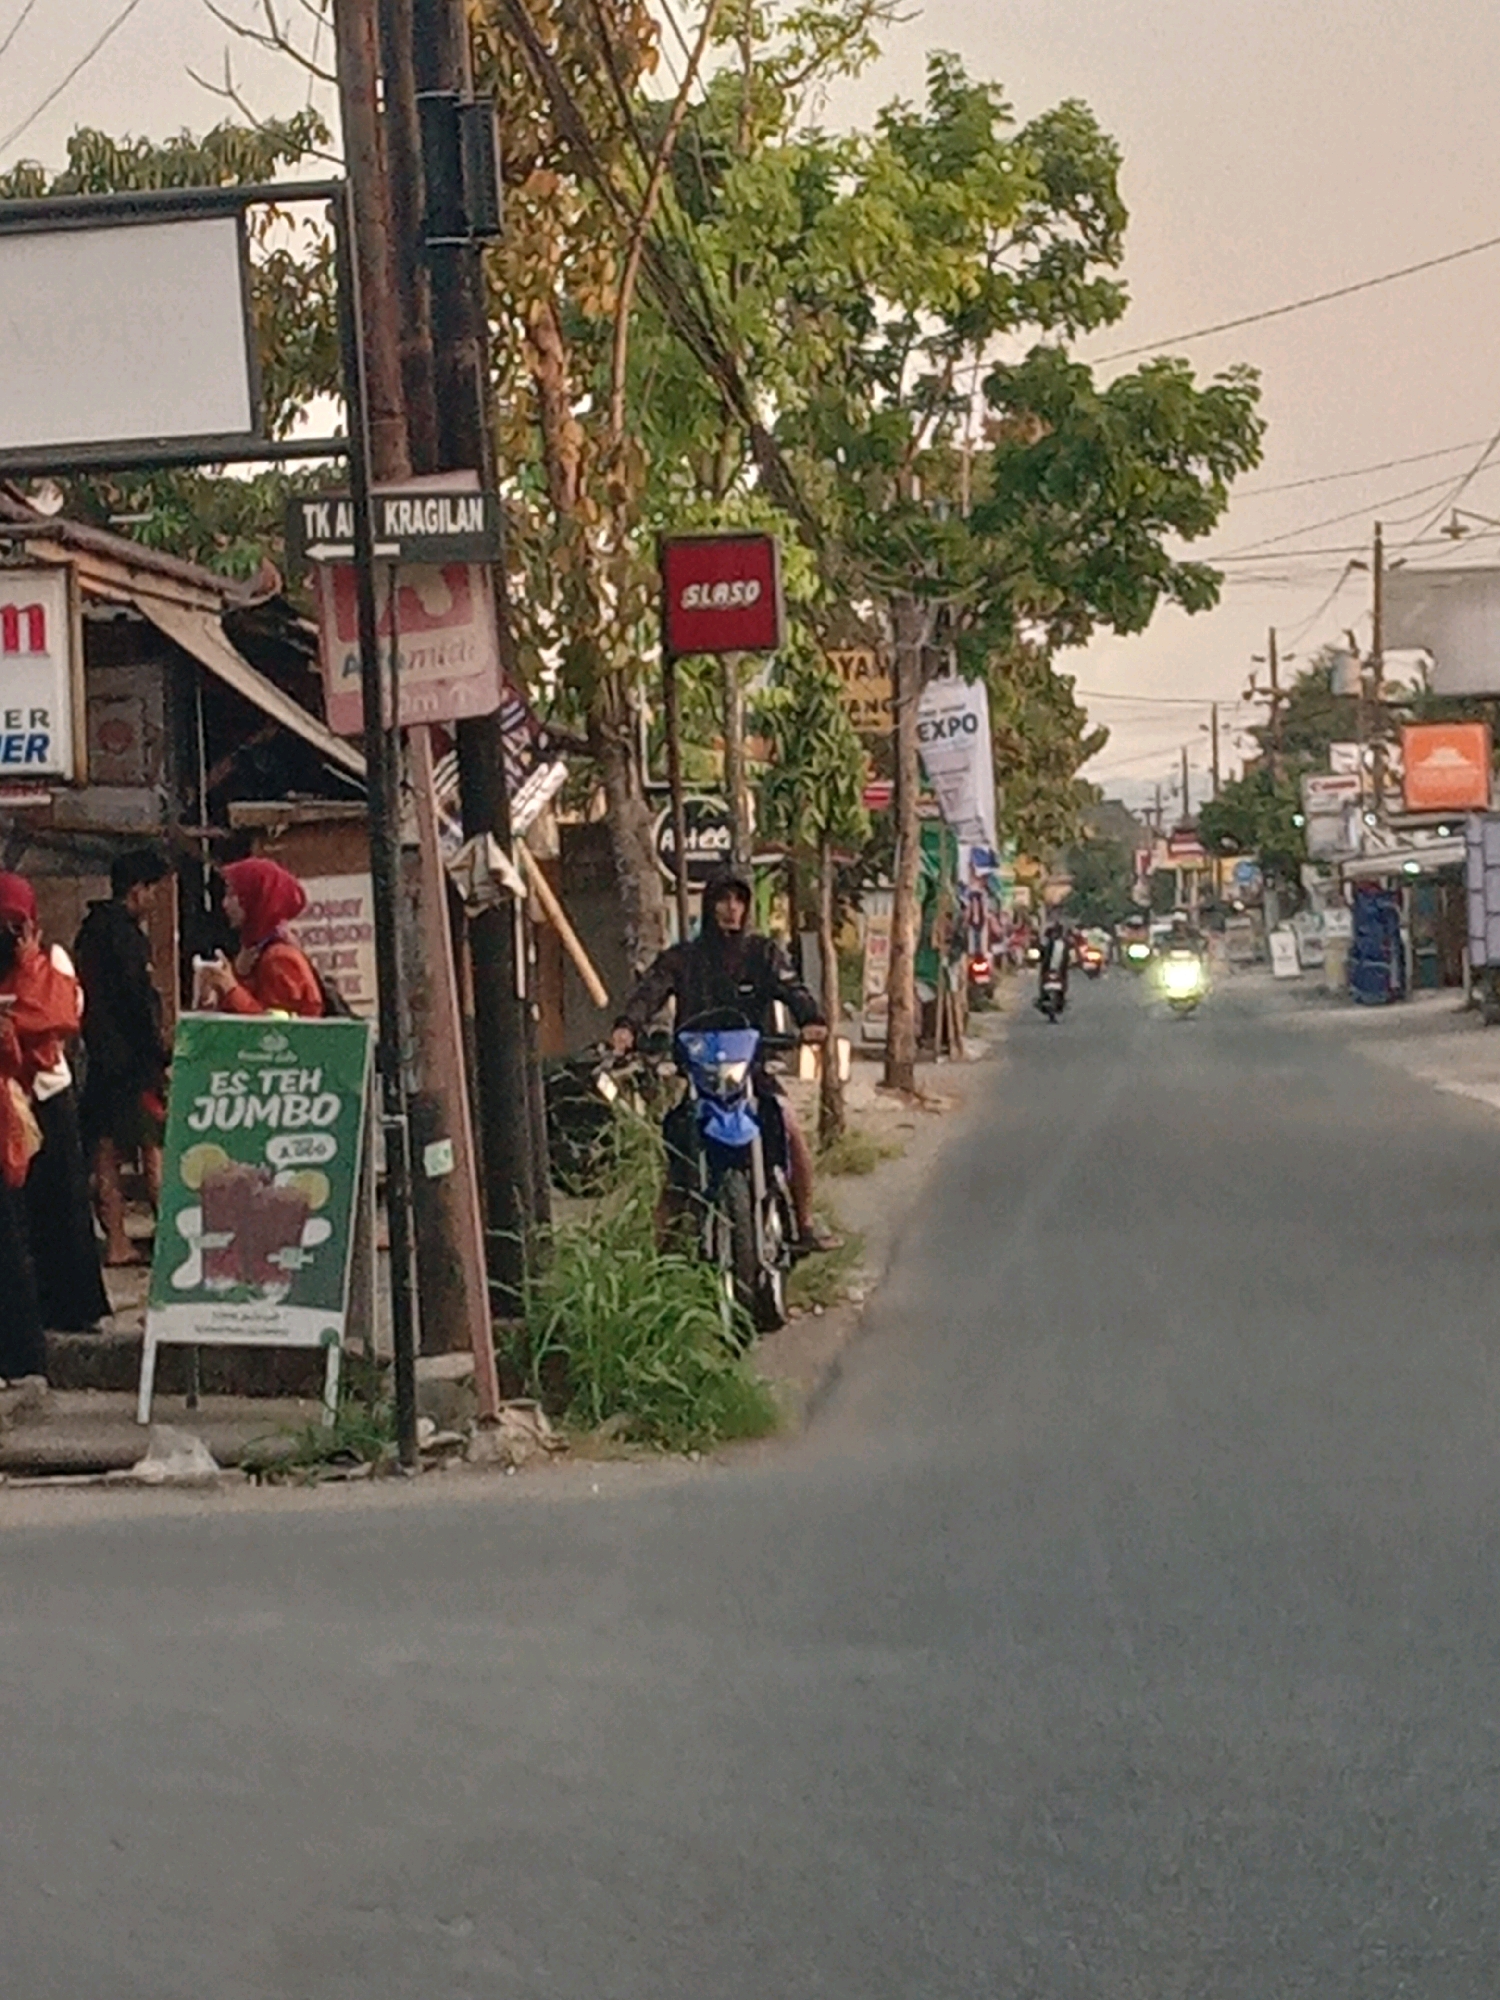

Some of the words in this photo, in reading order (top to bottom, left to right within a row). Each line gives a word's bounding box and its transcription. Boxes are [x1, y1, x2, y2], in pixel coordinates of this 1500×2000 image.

[302, 502, 331, 539] TK
[384, 498, 484, 536] KRAGILAN
[682, 579, 761, 610] SLASO
[916, 713, 978, 743] EXPO
[0, 733, 50, 763] ER
[210, 1069, 250, 1096] ES
[258, 1066, 323, 1095] TEH
[188, 1091, 341, 1132] JUMBO
